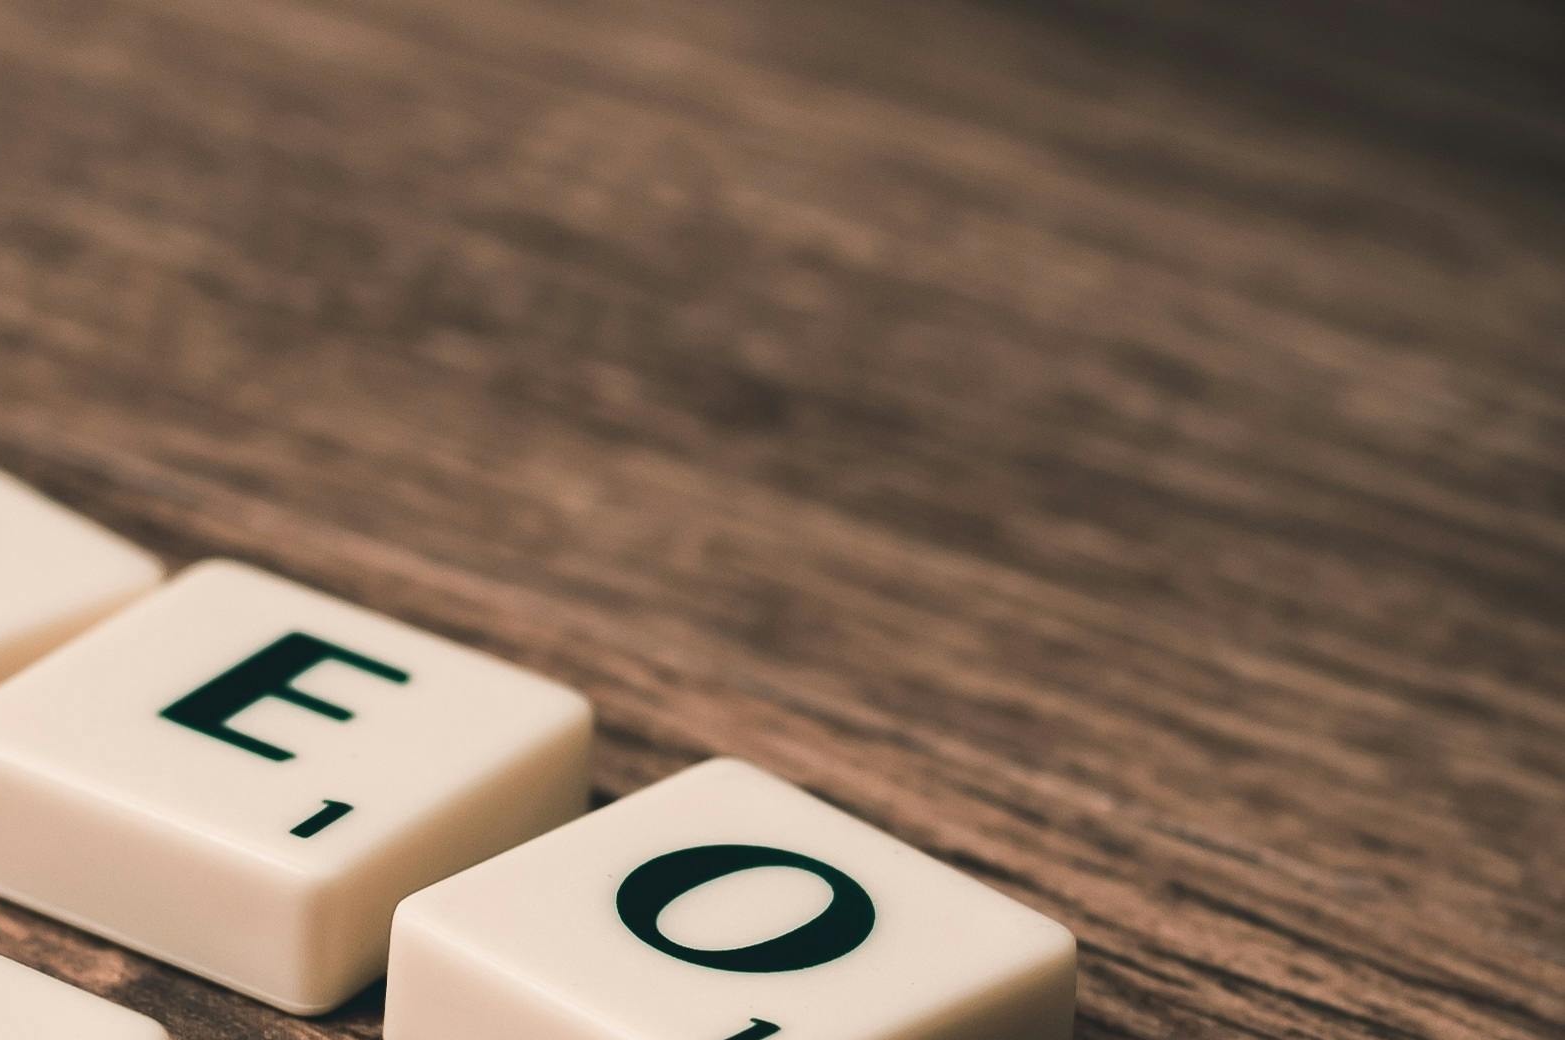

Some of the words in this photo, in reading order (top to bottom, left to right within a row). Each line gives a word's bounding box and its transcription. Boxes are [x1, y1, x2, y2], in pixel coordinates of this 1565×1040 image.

[157, 631, 411, 763] E
[288, 798, 355, 840] 1
[614, 843, 877, 974] O
